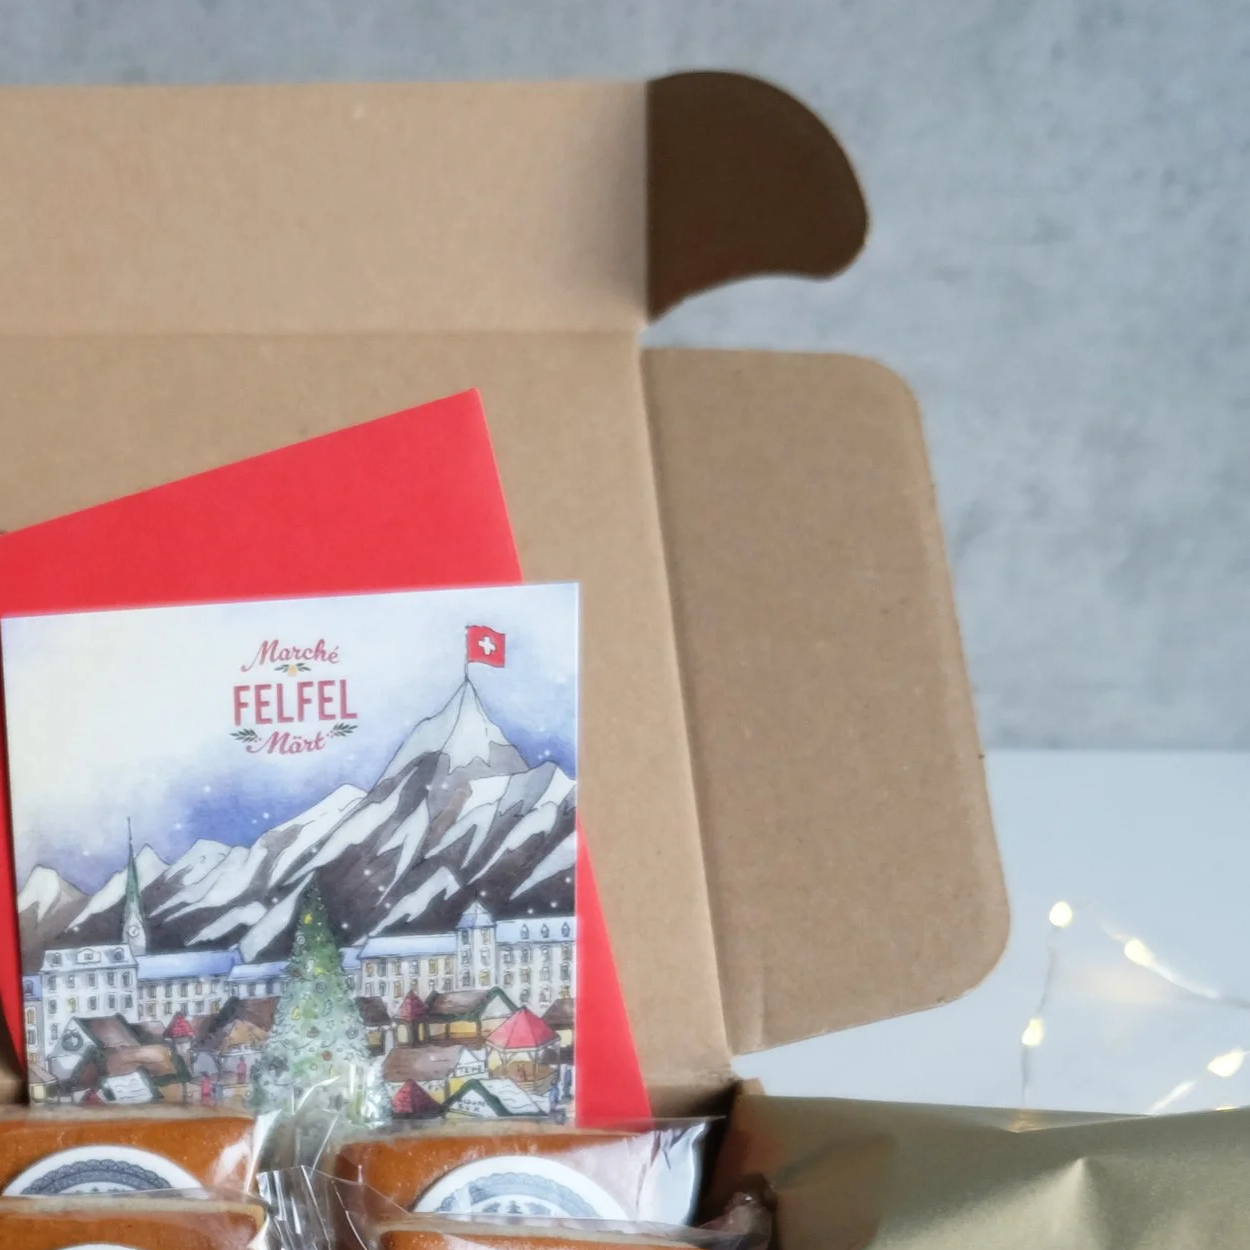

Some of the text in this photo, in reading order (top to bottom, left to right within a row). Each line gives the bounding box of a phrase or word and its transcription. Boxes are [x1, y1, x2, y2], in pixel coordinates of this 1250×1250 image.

[240, 638, 341, 673] Marché
[232, 679, 359, 727] FELFEL
[245, 730, 328, 756] Märt
